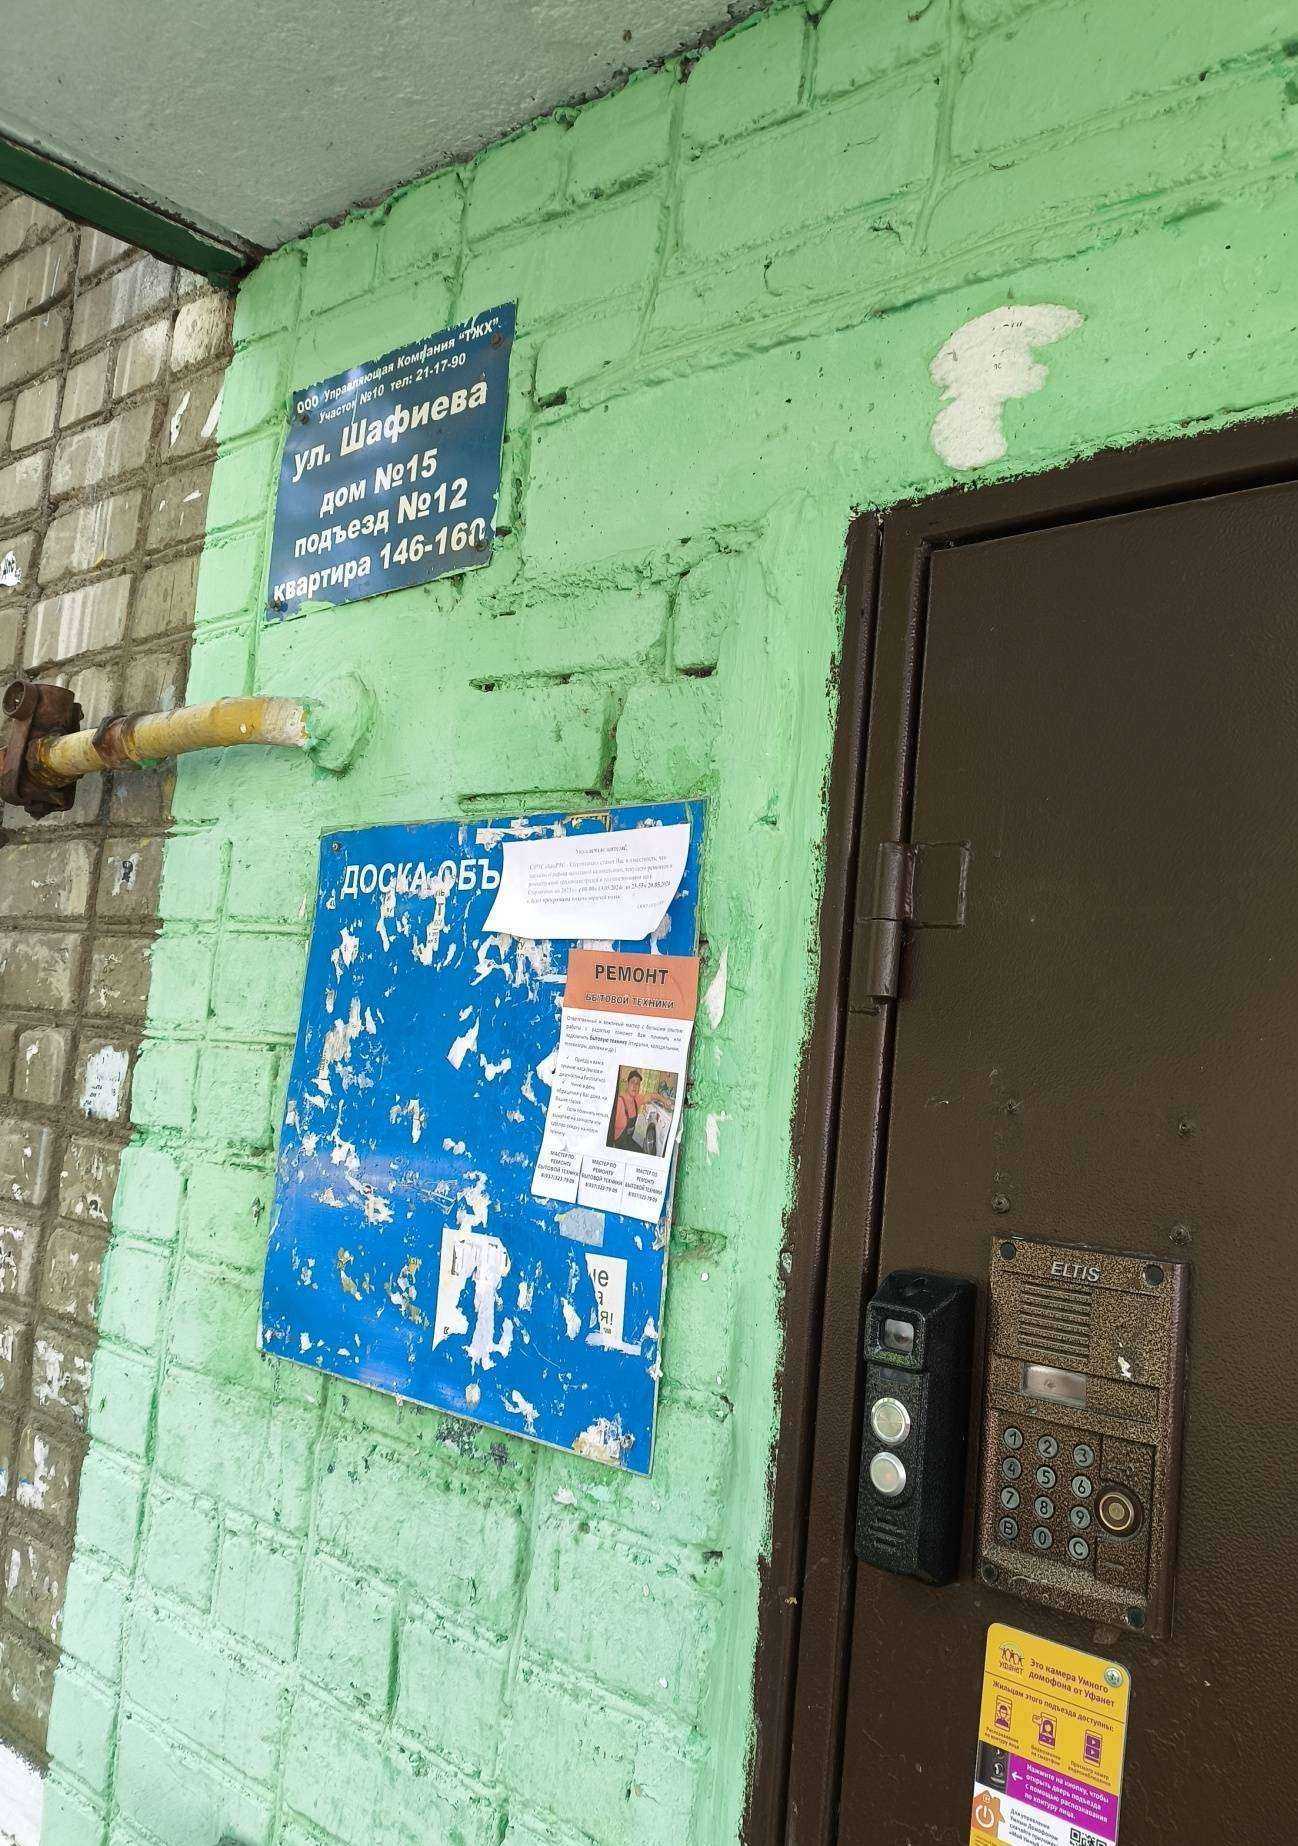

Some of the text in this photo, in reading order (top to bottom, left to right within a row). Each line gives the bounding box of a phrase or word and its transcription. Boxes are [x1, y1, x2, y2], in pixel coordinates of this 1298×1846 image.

[297, 394, 318, 414] ООО
[324, 362, 394, 402] Управляющая
[319, 352, 466, 423] Участок №10 тел: 21-17-90
[292, 380, 488, 483] ул. Шафиева
[319, 449, 437, 518] дом №15
[295, 477, 468, 558] подъезд №12
[273, 517, 486, 602] квартира 146-160
[594, 964, 669, 986] РЕМОНТ
[585, 992, 675, 1009] БЫТОВОЙ ТЕХНИКИ
[1050, 1261, 1101, 1283] ELTIS
[1029, 1671, 1071, 1692] домофона
[1084, 1690, 1115, 1707] Уфанет
[1030, 1658, 1109, 1694] Это камера Умного
[992, 1680, 1114, 1732] Жильцам этого подъезда доступны:
[1026, 1764, 1109, 1804] Нажмите на кнопку, чтобы
[1026, 1774, 1101, 1810] открыть дверь подъезда
[1024, 1793, 1076, 1819] по контуру лица.
[1030, 1785, 1060, 1802] помощью
[1060, 1798, 1108, 1823] распознавания
